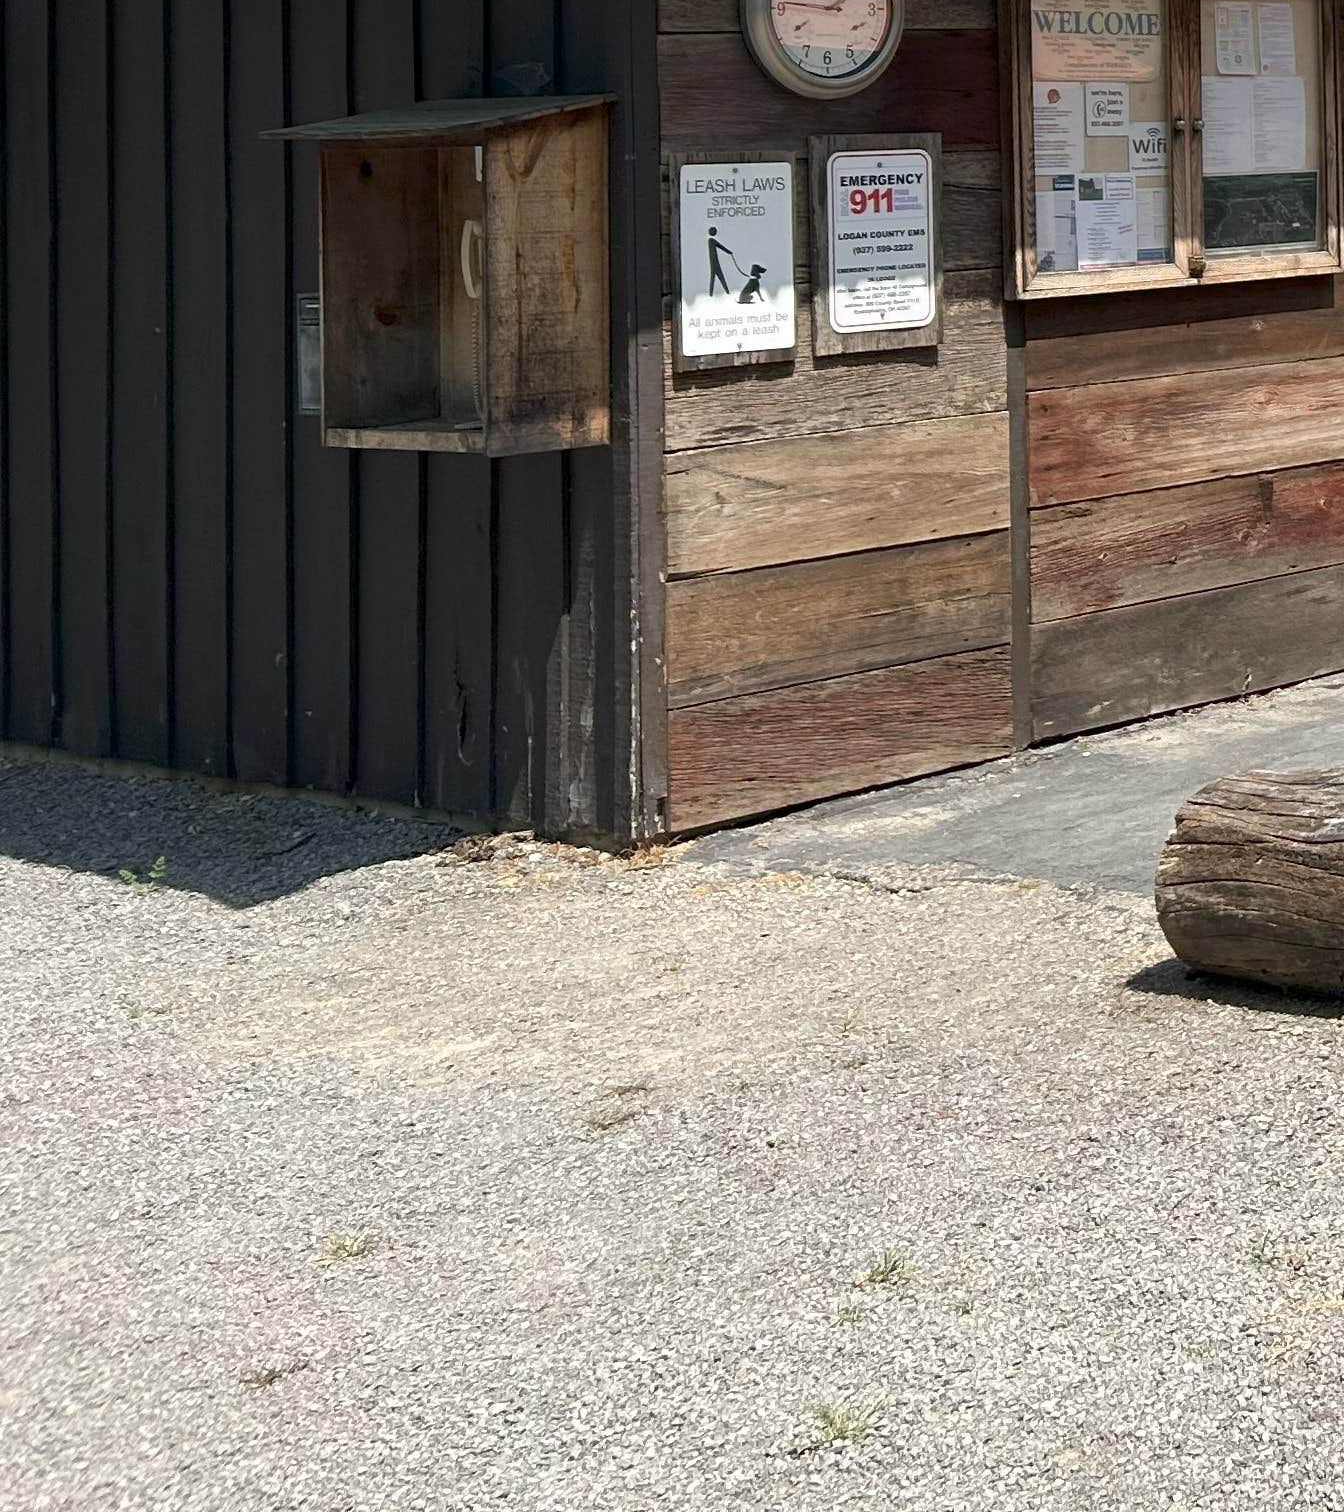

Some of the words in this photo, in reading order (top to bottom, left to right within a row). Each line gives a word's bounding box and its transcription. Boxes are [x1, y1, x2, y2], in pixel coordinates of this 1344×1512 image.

[776, 2, 786, 17] 9
[867, 3, 876, 17] 3
[1033, 9, 1161, 37] WELCOME
[801, 44, 811, 58] 7
[823, 50, 832, 65] 6
[845, 44, 854, 59] 5
[686, 178, 736, 194] LEASH
[742, 176, 786, 192] LAWS
[840, 173, 923, 187] EMERGENCY
[711, 195, 760, 207] STRICTLY
[849, 188, 893, 215] 911
[706, 206, 766, 219] ENFORCED
[838, 232, 867, 240] LOGAN
[870, 230, 905, 239] COUNTY
[907, 228, 926, 237] EMS
[688, 317, 701, 328] All
[704, 315, 743, 327] animals
[747, 313, 771, 324] must
[775, 312, 788, 321] be
[698, 328, 720, 340] kept
[725, 329, 737, 337] on
[742, 328, 748, 336] a
[752, 325, 780, 335] leash
